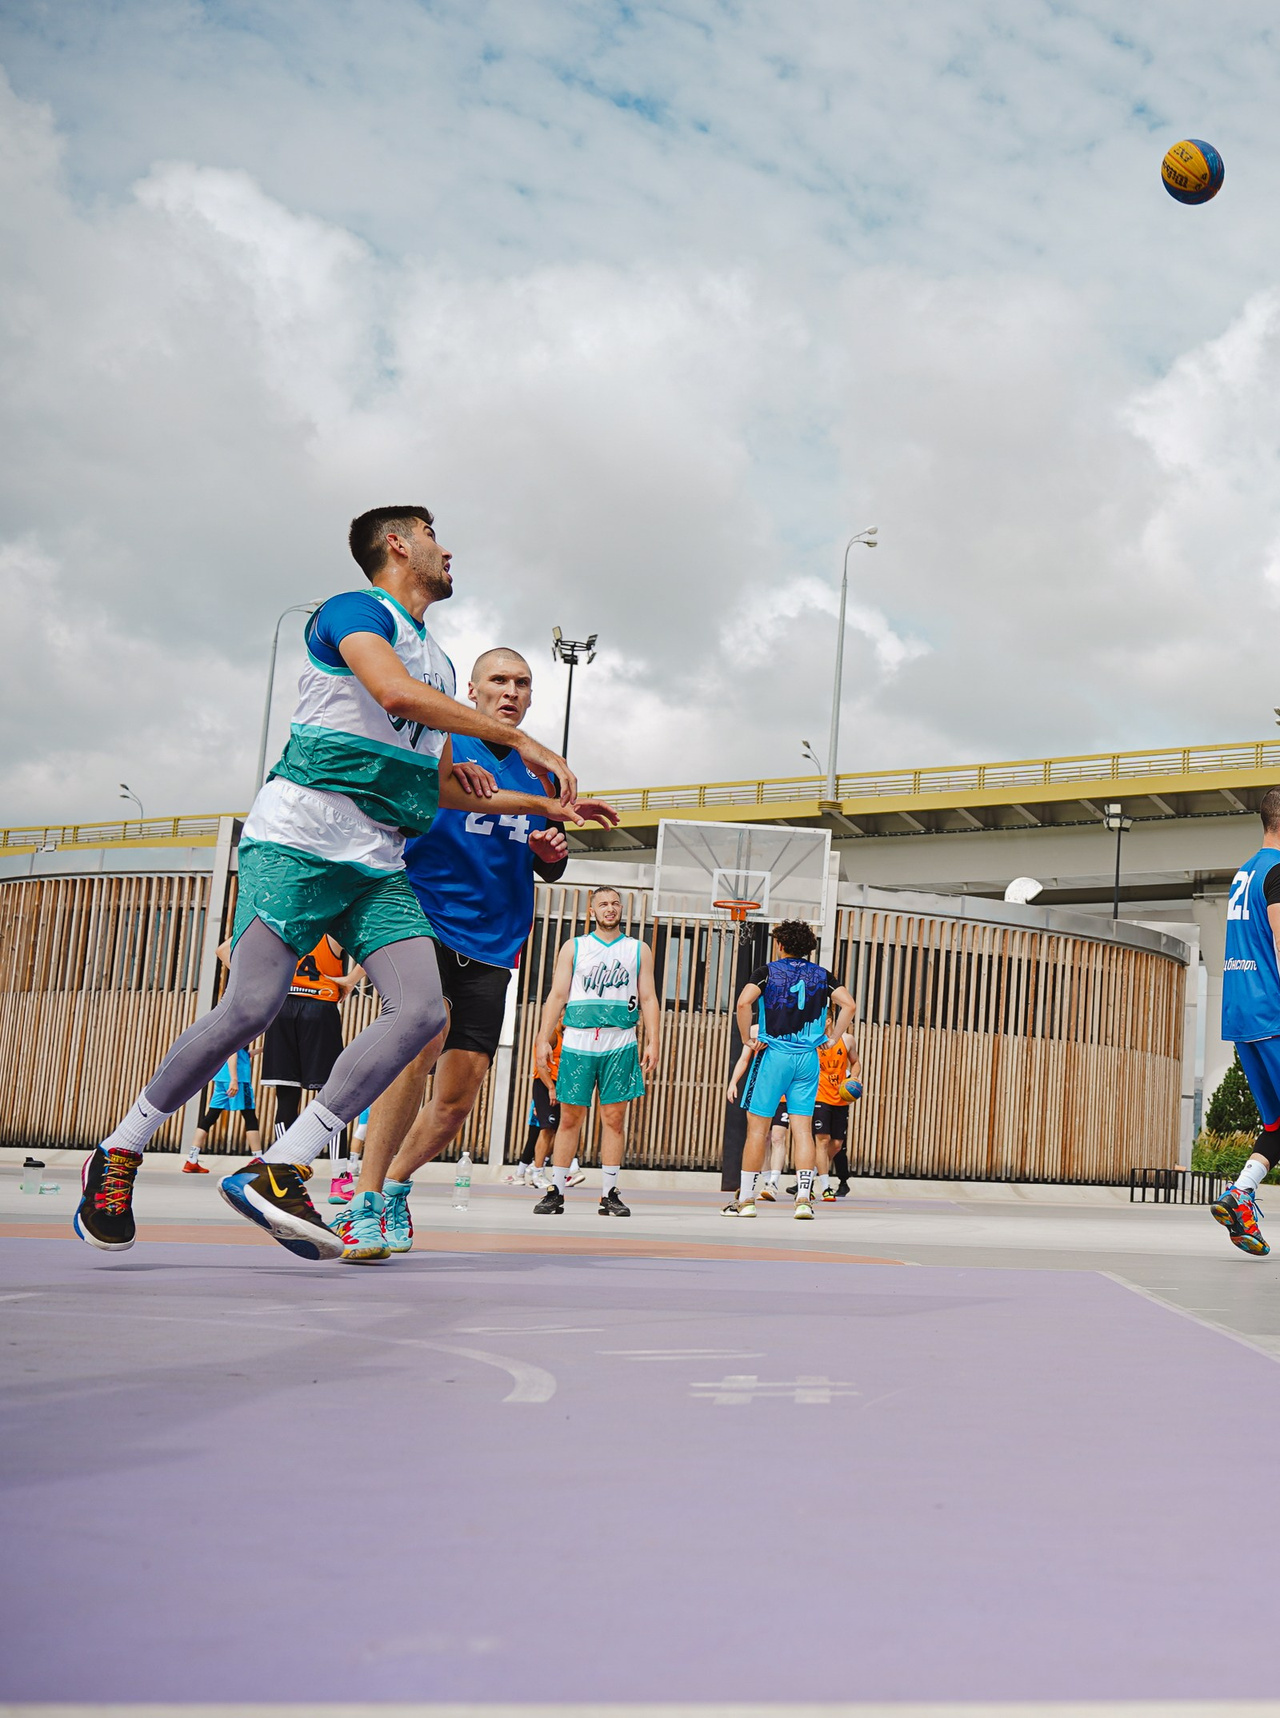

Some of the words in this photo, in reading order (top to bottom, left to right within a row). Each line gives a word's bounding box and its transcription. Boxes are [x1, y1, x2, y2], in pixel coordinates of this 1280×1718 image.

[1226, 870, 1256, 921] 21
[296, 954, 321, 982] 4
[582, 958, 630, 998] Alpha
[627, 995, 637, 1013] 5
[789, 979, 806, 1011] 1
